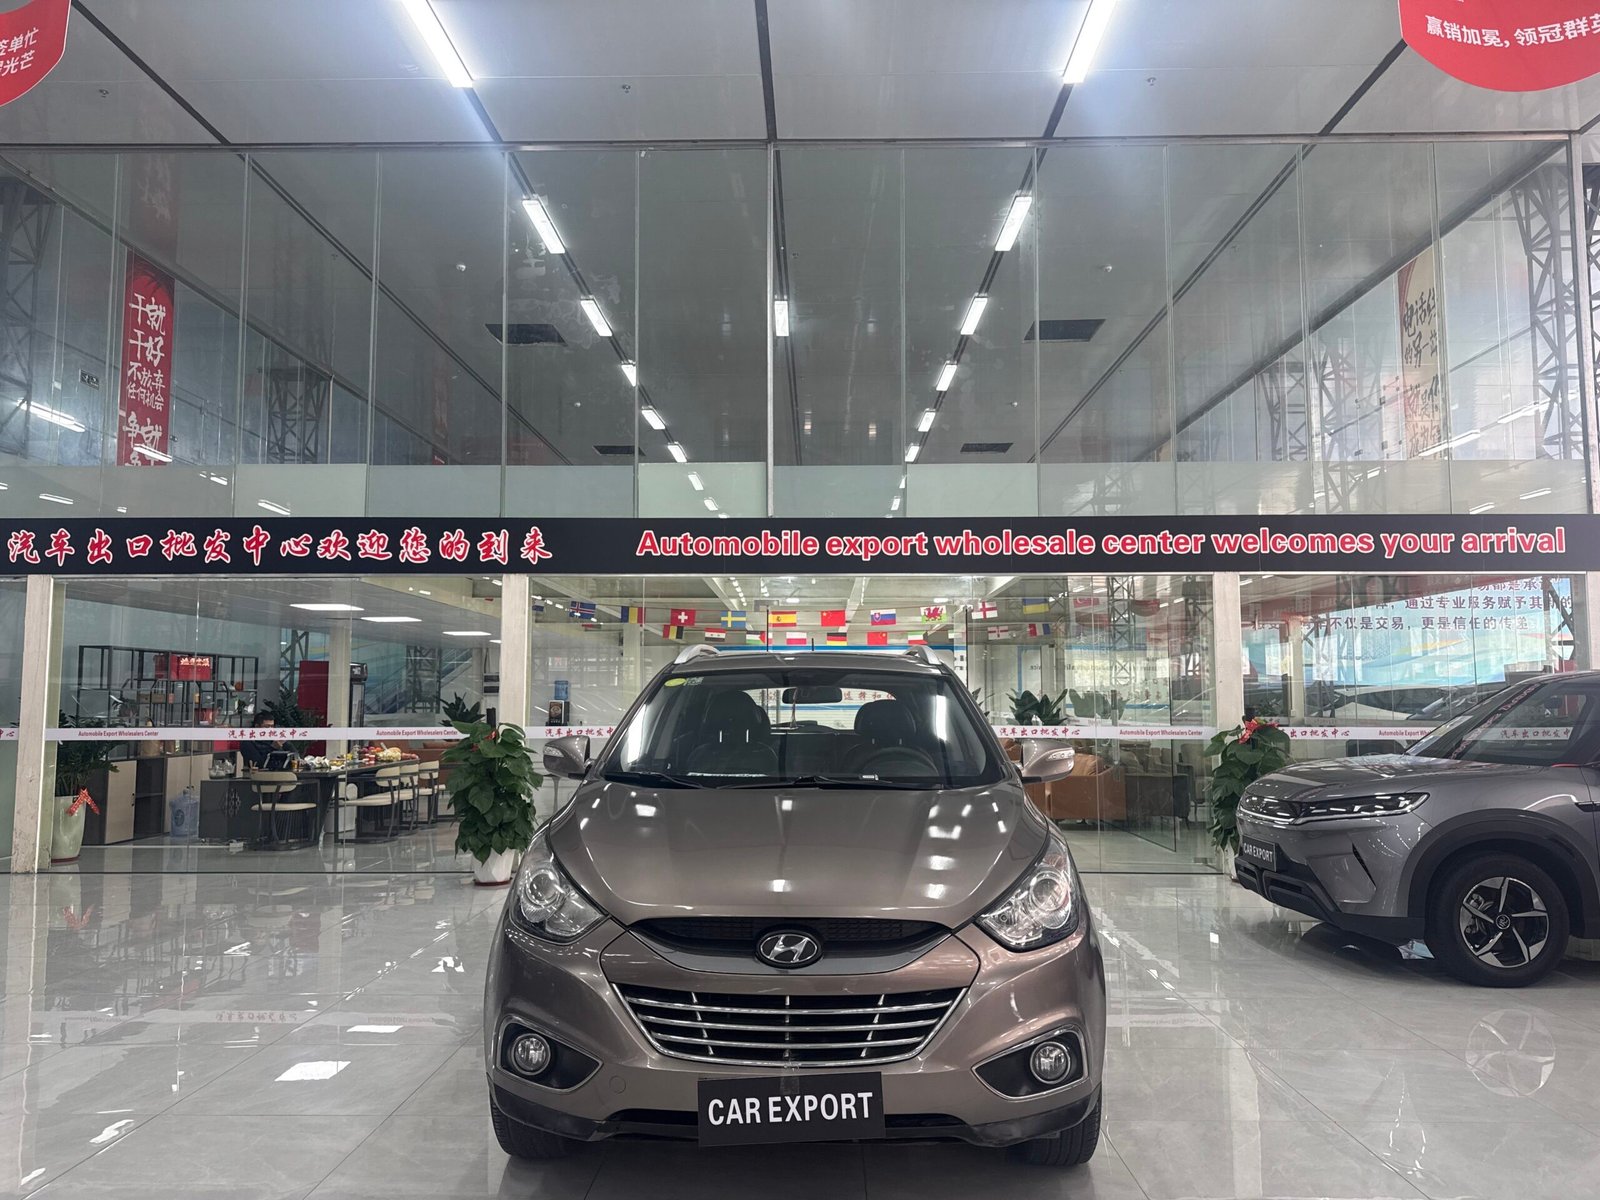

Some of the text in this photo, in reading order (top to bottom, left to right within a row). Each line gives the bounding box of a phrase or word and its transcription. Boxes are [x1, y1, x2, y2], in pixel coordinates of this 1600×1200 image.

[7, 525, 553, 567] 汽车出口批发中心欢迎您的到来
[636, 527, 1565, 561] Automobile export wholesale center welcomes your arrival
[228, 729, 309, 739] 汽车出口批发中心
[402, 729, 416, 737] Export
[999, 727, 1081, 738] 汽车出口批发中心
[1145, 729, 1161, 737] Export
[1284, 728, 1351, 738] 出口批发中心
[708, 1091, 873, 1126] CAR EXPORT
